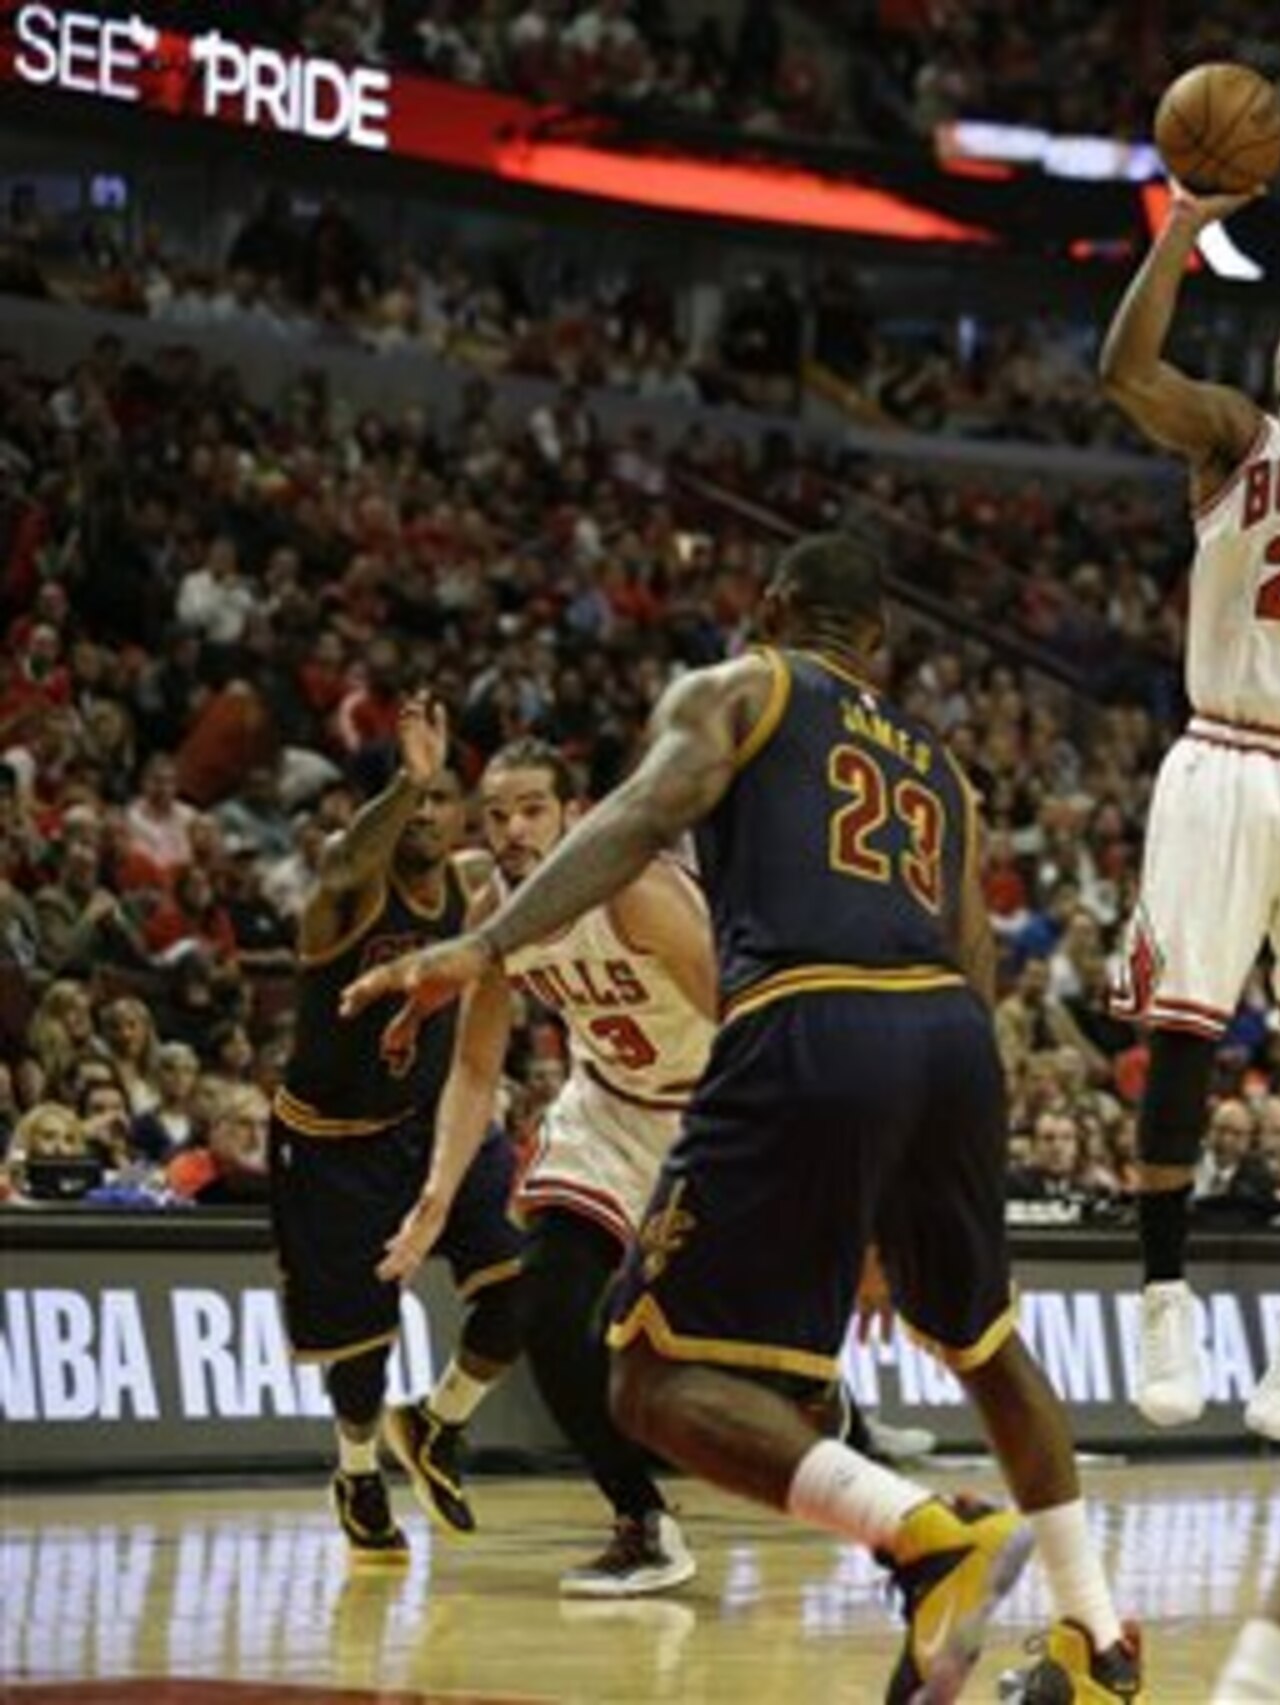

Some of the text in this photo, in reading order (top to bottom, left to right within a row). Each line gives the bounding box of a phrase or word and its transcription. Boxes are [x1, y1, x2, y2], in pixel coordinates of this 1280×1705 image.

[14, 4, 391, 150] SEE PRIDE
[828, 744, 944, 916] 23
[503, 957, 650, 1007] ULLS
[588, 1014, 661, 1070] 3
[170, 1289, 434, 1420] RAO
